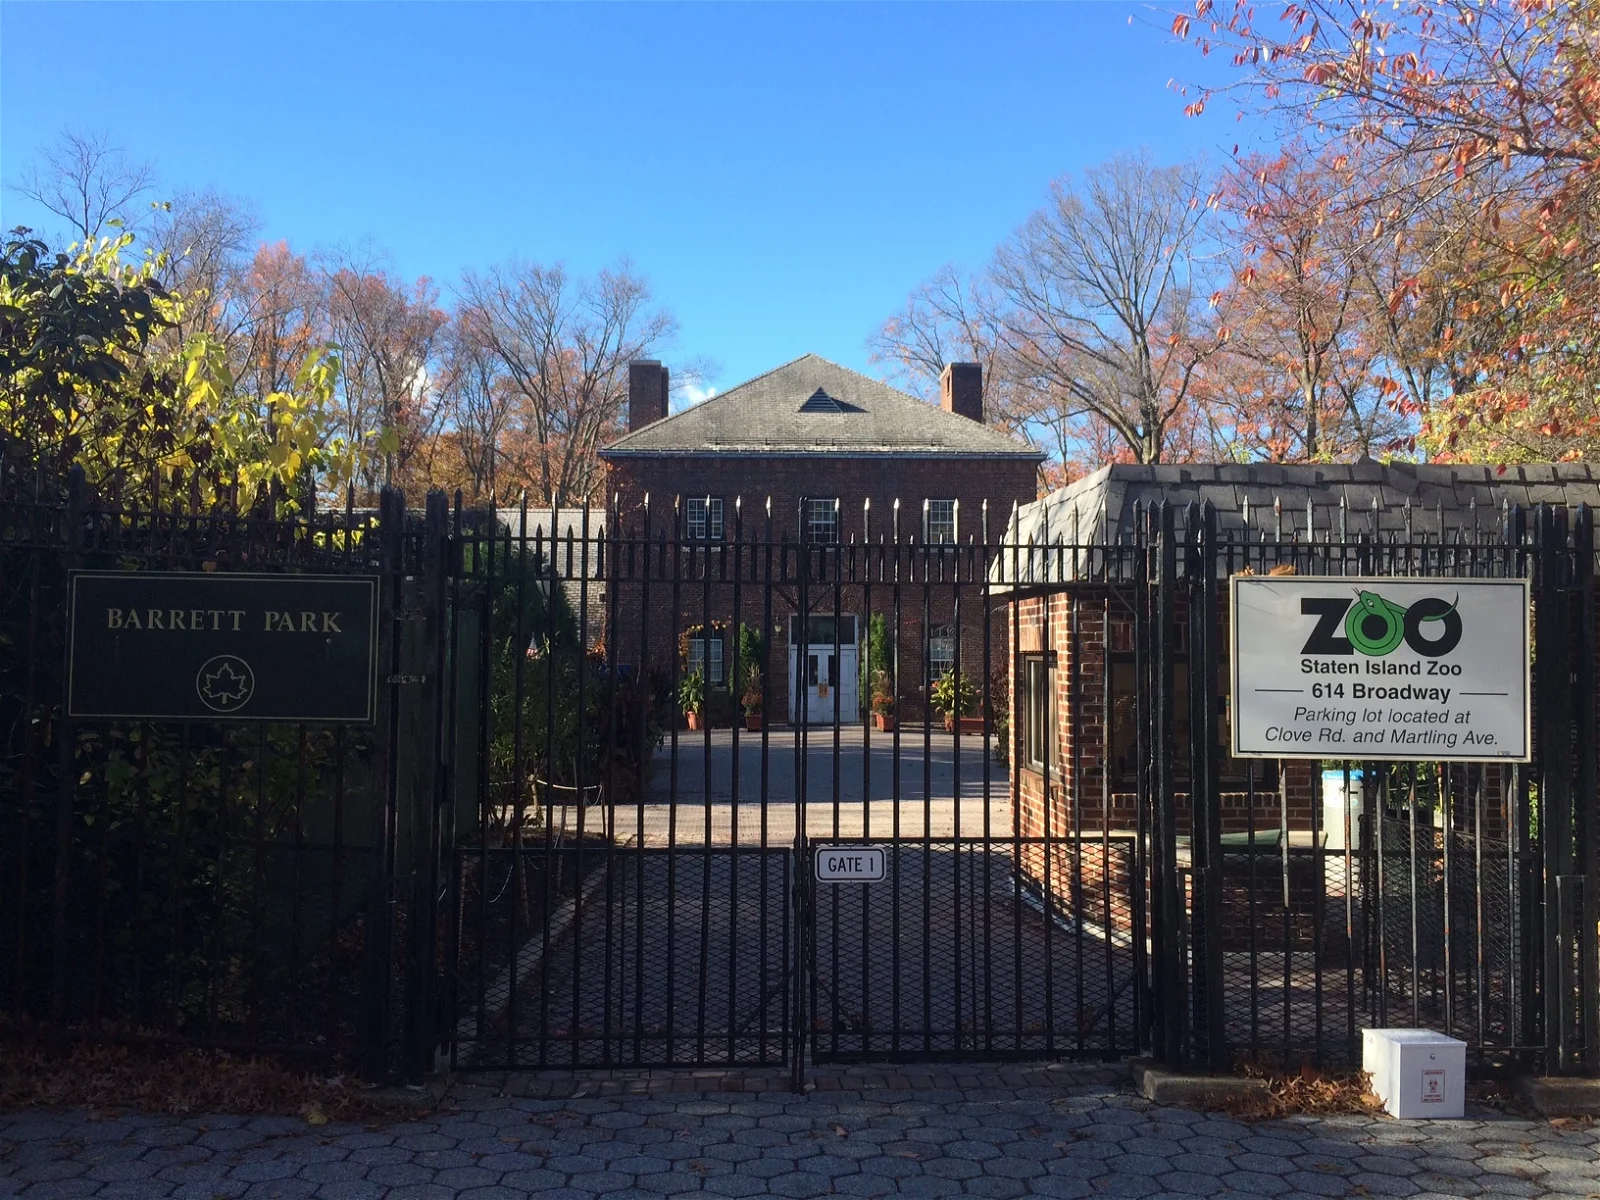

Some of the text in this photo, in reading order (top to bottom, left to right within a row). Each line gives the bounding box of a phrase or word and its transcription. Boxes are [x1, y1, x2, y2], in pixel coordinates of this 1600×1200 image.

[107, 609, 341, 632] BARRETT PARK
[1300, 594, 1463, 658] ZOO
[1301, 659, 1462, 675] Staten Island Zoo
[1312, 683, 1450, 704] 614 Broadway
[1295, 707, 1470, 725] Parking lot located at
[1266, 727, 1497, 748] Clove Rd. and Martling Ave.
[828, 857, 874, 872] GATE 1
